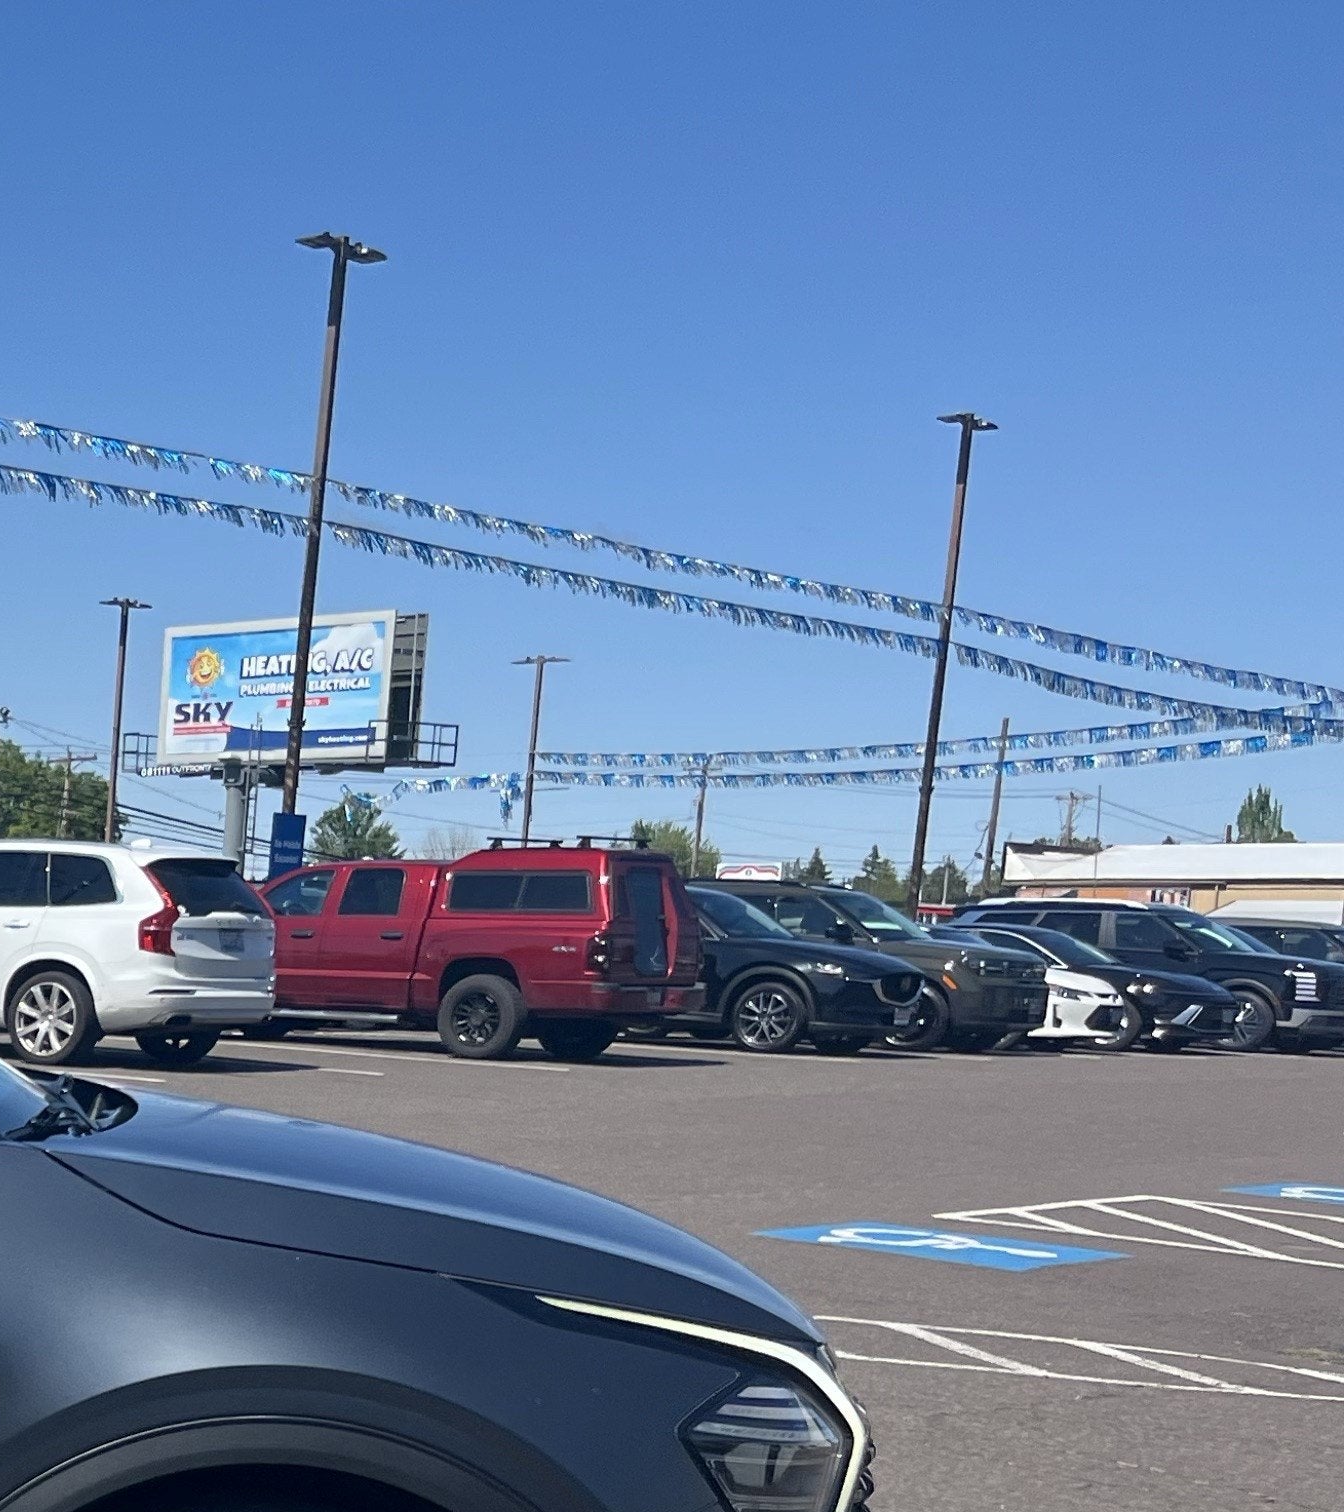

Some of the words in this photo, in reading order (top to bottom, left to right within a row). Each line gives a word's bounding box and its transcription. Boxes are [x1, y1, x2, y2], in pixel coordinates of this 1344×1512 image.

[333, 648, 374, 673] A/C
[306, 677, 371, 693] ELECTRICAL
[173, 701, 234, 724] SKY
